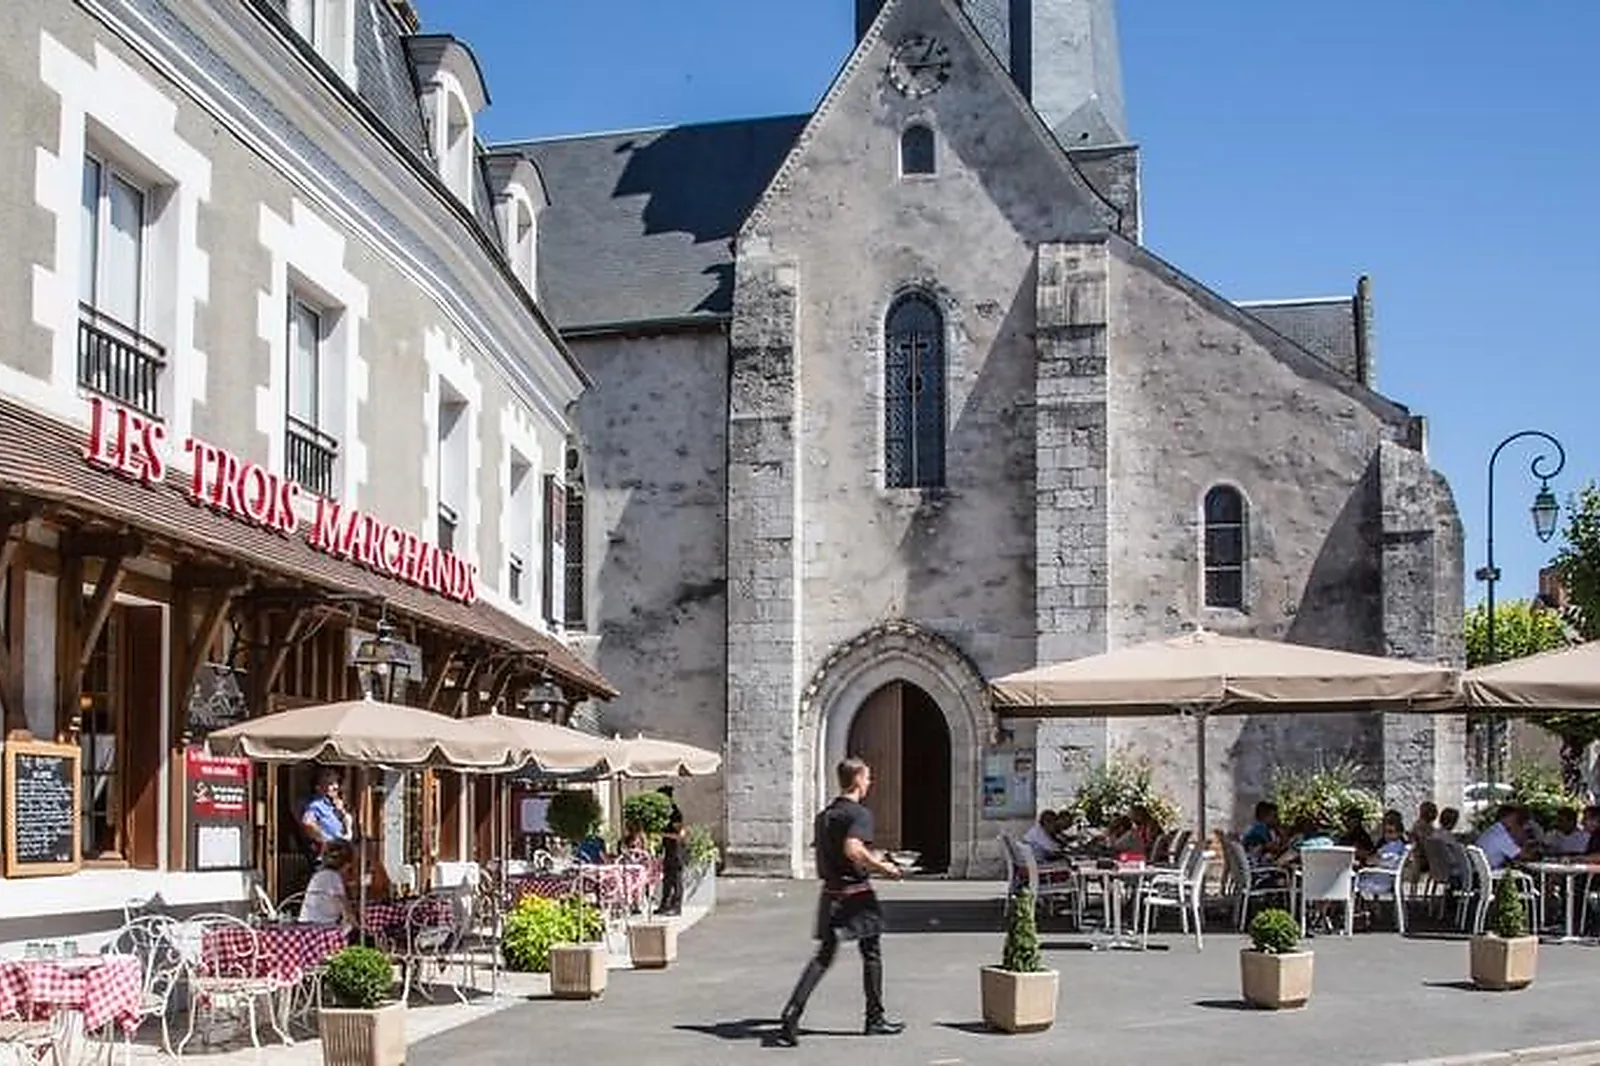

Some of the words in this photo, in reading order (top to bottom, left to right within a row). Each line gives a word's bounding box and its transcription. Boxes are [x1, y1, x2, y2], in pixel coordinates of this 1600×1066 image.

[81, 396, 166, 483] LES
[185, 439, 301, 534] TROIS
[307, 497, 478, 604] MARCHANDS
